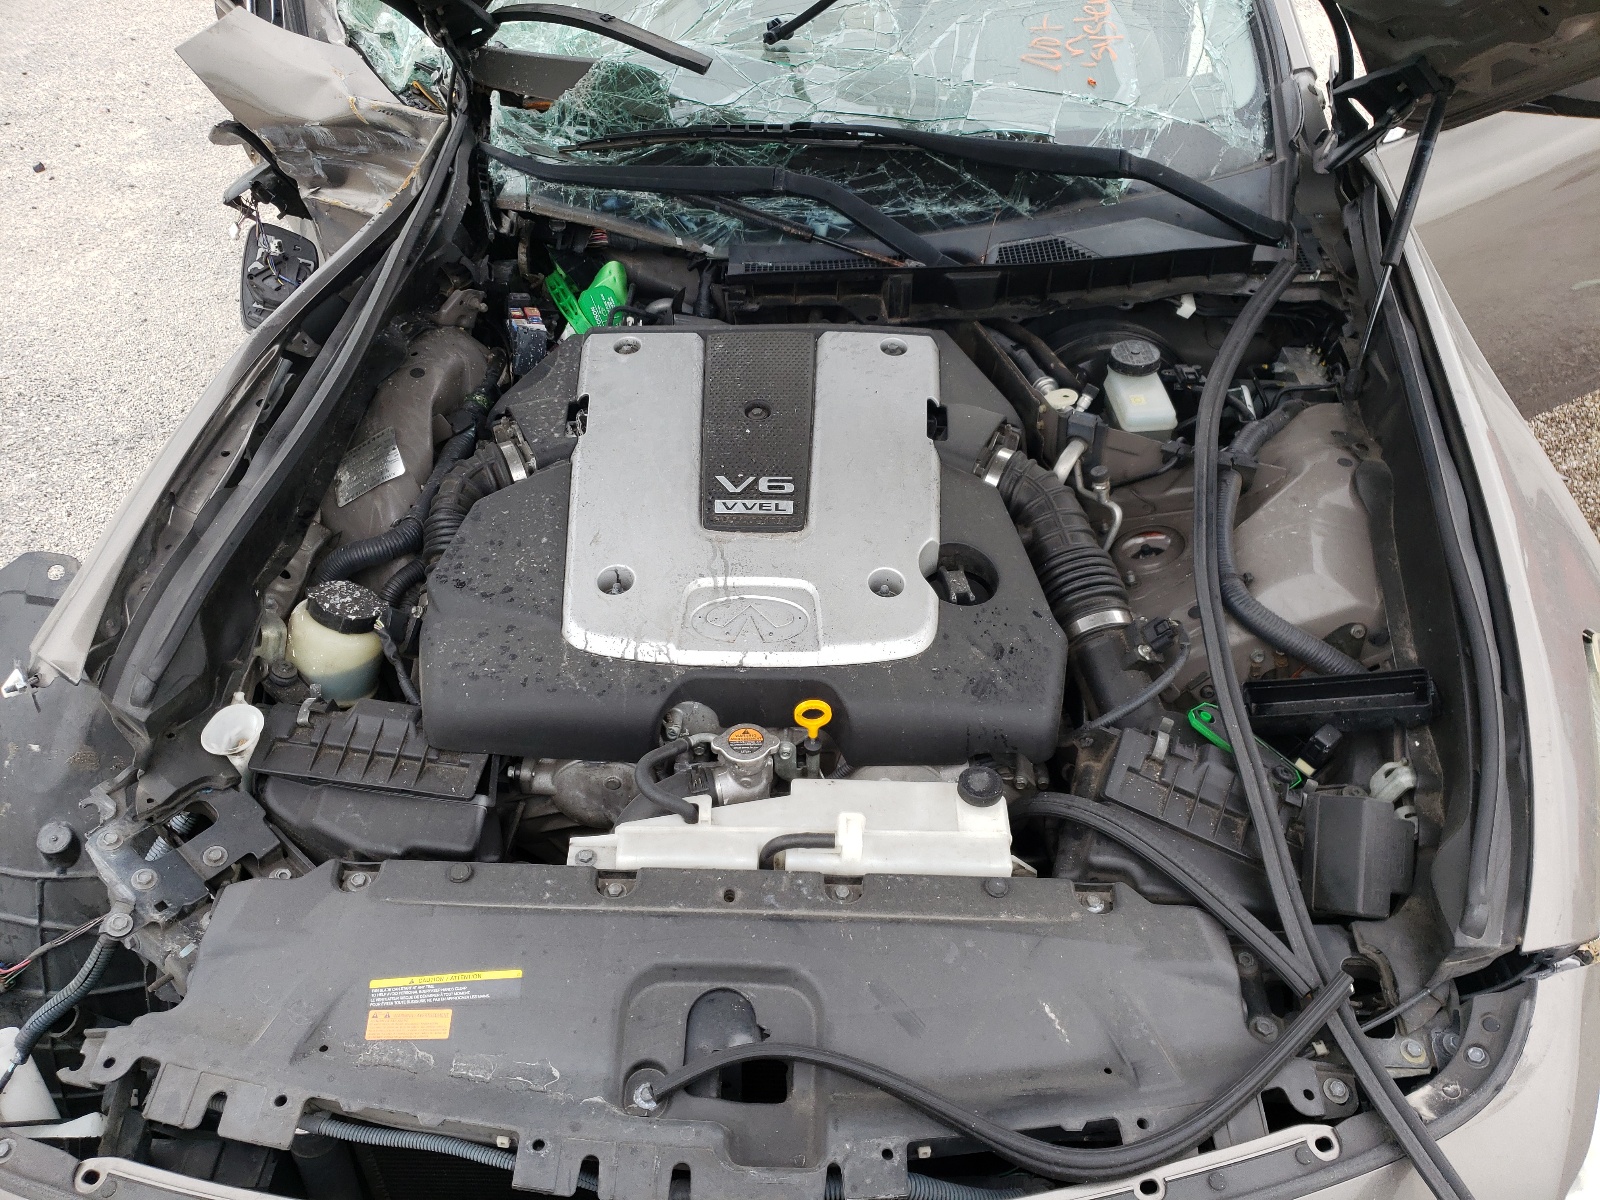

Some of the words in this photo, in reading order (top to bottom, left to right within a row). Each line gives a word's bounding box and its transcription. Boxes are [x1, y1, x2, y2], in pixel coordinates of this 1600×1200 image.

[714, 475, 795, 493] V6
[721, 501, 787, 512] VVEL
[418, 976, 444, 984] CAUTION
[450, 973, 482, 981] ATTENTION
